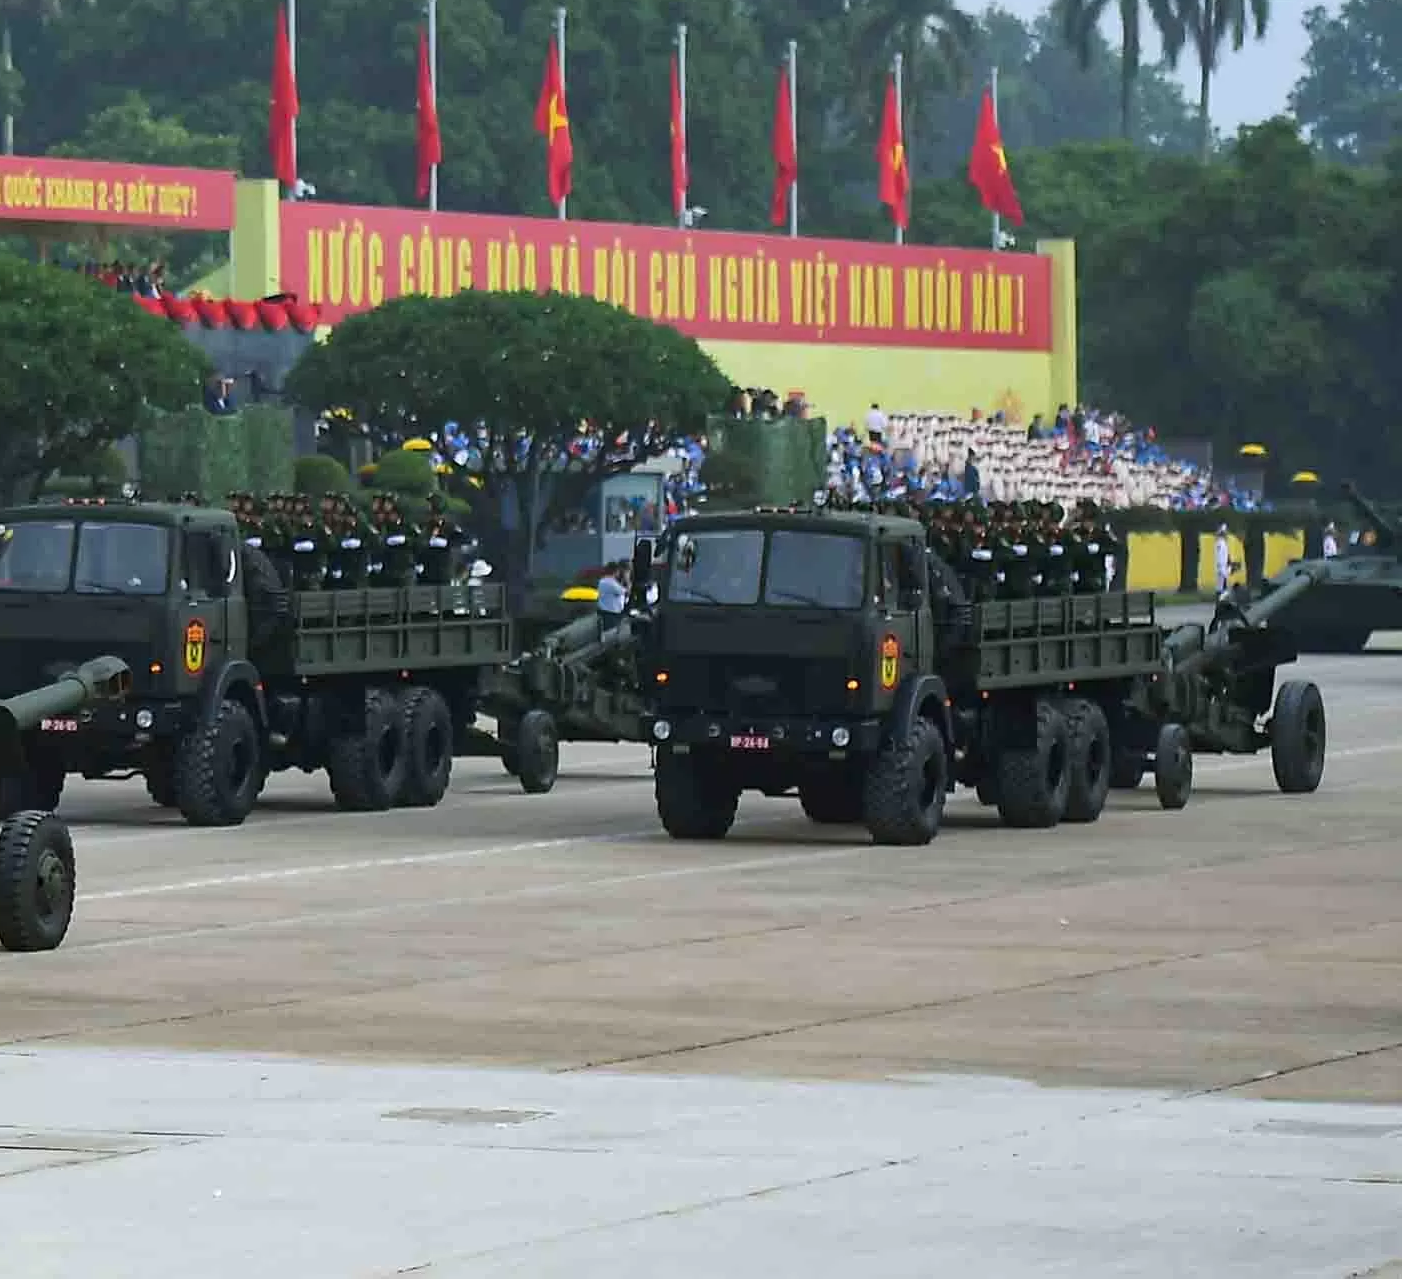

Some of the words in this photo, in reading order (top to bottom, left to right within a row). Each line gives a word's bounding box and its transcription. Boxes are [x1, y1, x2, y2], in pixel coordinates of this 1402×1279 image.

[308, 218, 384, 307] NƯỚC
[709, 248, 780, 325] NGHĨA
[790, 250, 839, 338] VIỆT
[849, 263, 894, 330] NAM
[904, 258, 962, 333] MUÔN
